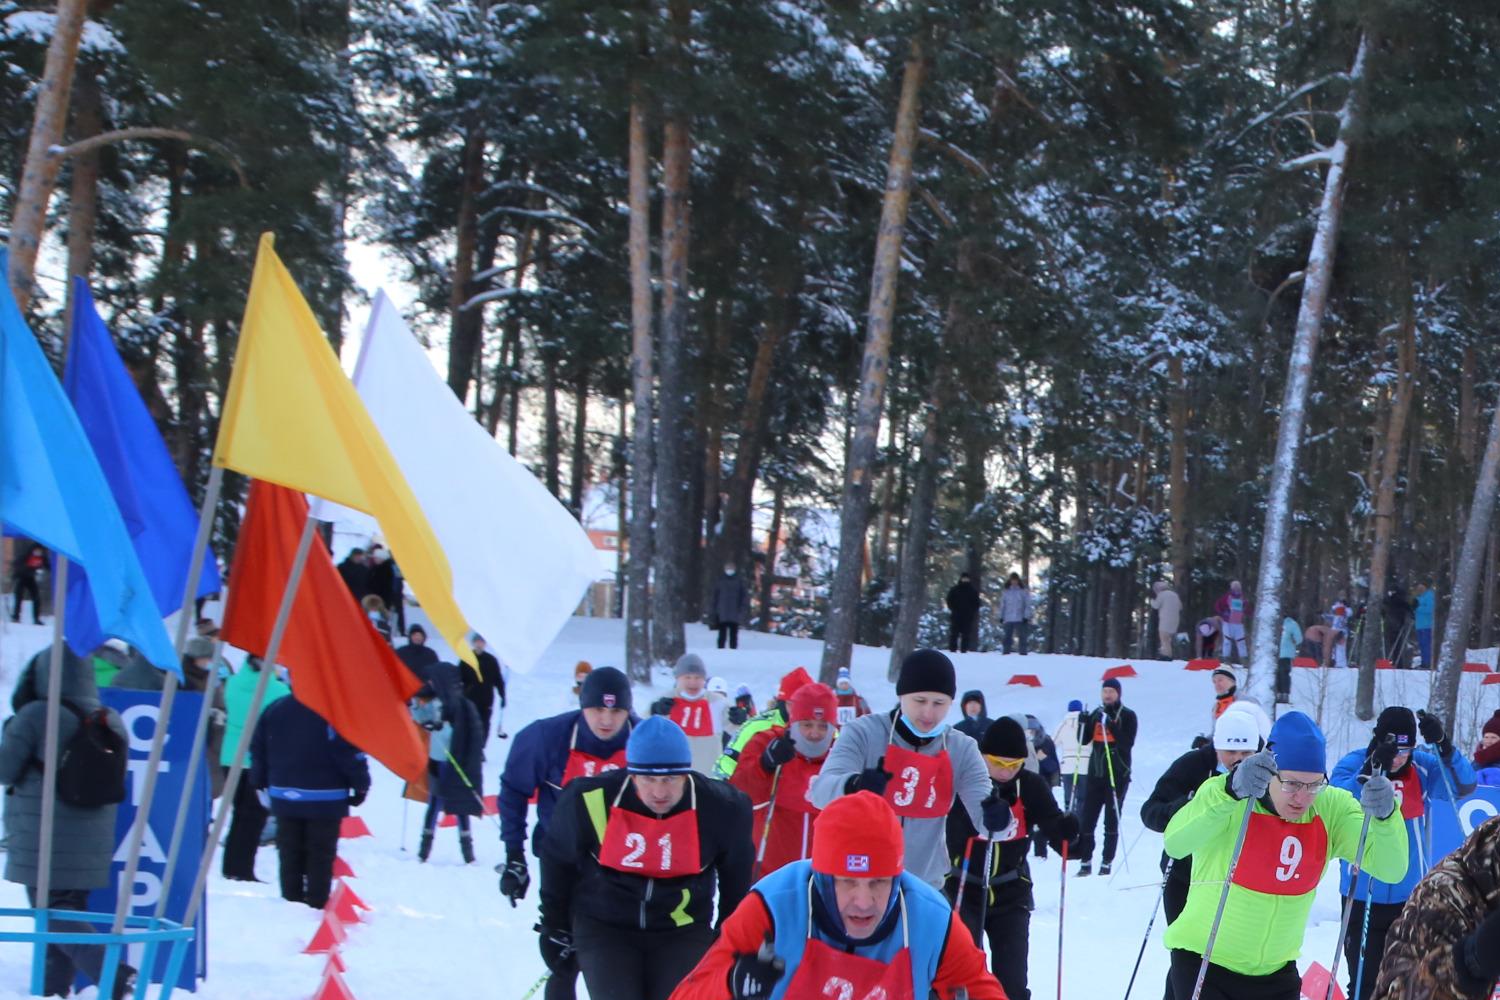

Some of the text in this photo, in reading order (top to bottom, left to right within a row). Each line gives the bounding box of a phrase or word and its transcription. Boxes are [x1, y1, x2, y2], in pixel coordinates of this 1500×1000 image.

[681, 706, 702, 729] 11
[893, 766, 937, 809] 31
[620, 832, 672, 871] 21
